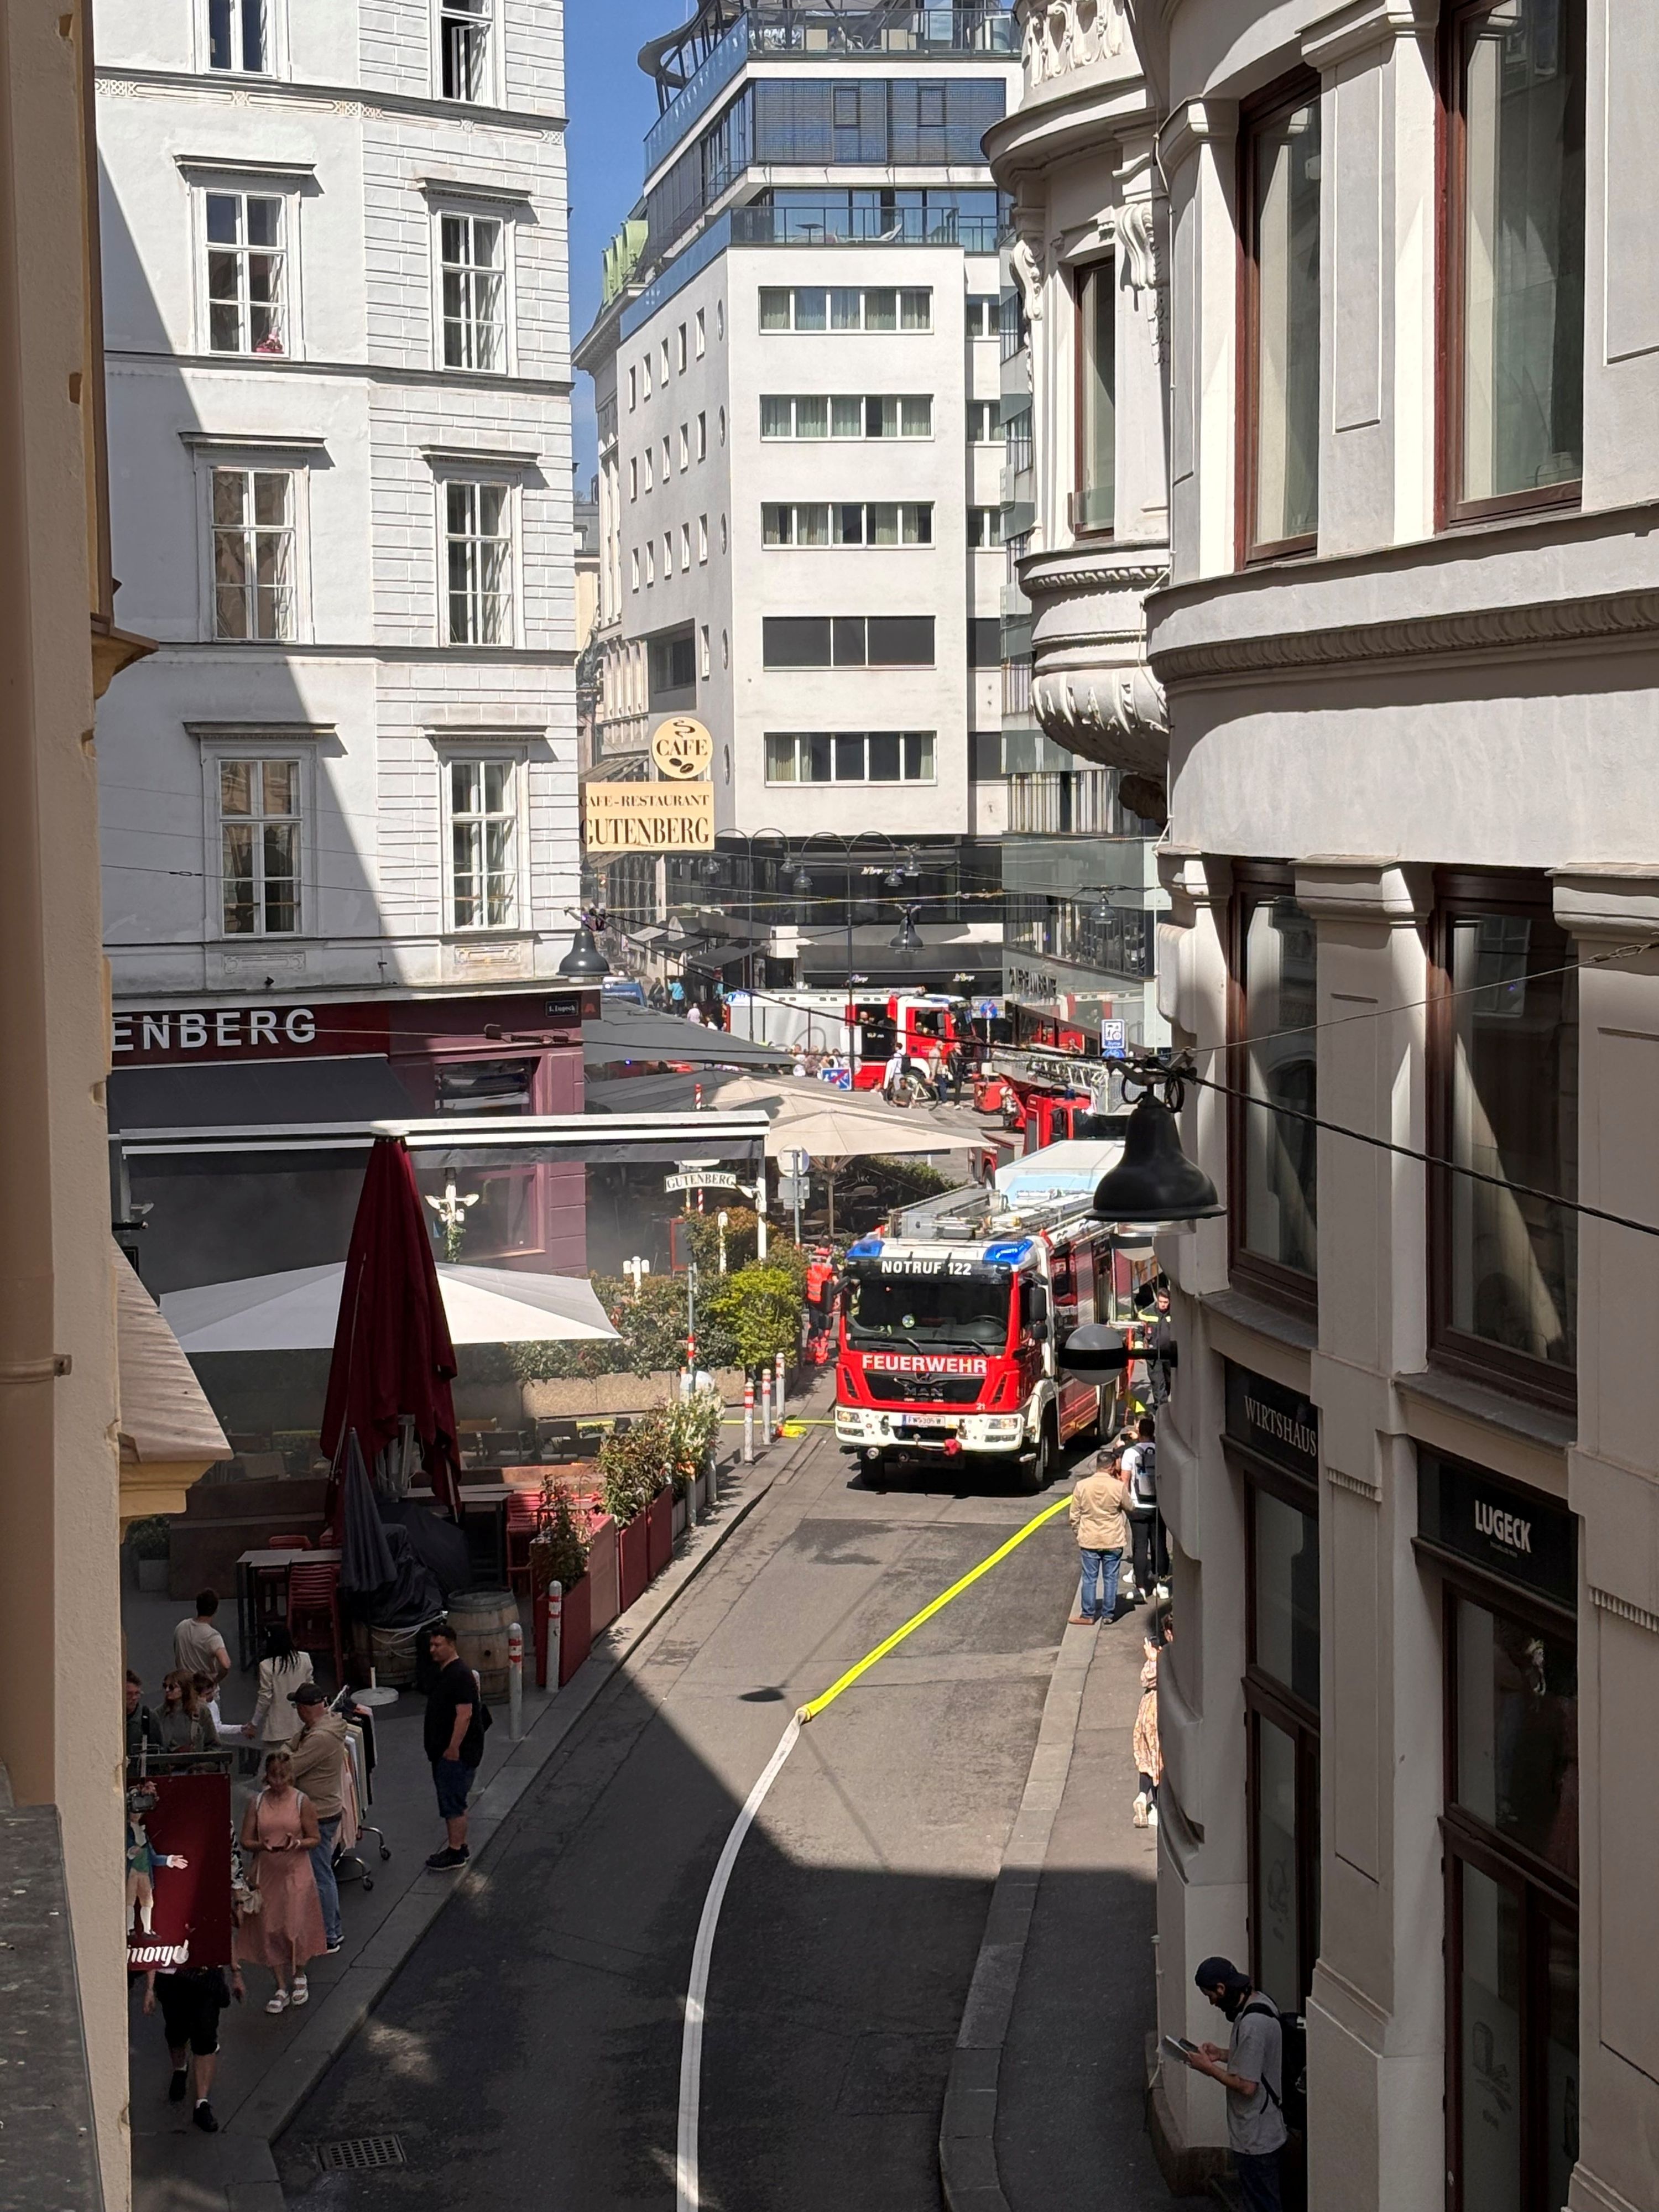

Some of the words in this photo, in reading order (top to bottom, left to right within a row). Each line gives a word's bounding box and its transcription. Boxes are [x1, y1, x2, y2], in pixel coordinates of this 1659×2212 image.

[656, 739, 708, 756] CAFE
[581, 817, 709, 845] GUTENBERG
[112, 1009, 316, 1051] ENBERG
[667, 1174, 734, 1188] GUTENBERG
[881, 1260, 942, 1274] NOTRUF
[948, 1262, 972, 1275] 122
[862, 1354, 987, 1373] FEUERWEHR
[904, 1387, 943, 1396] MAN
[976, 1402, 986, 1411] 21
[1244, 1395, 1317, 1457] WIRTSHAUS
[1475, 1499, 1531, 1553] LUGECK
